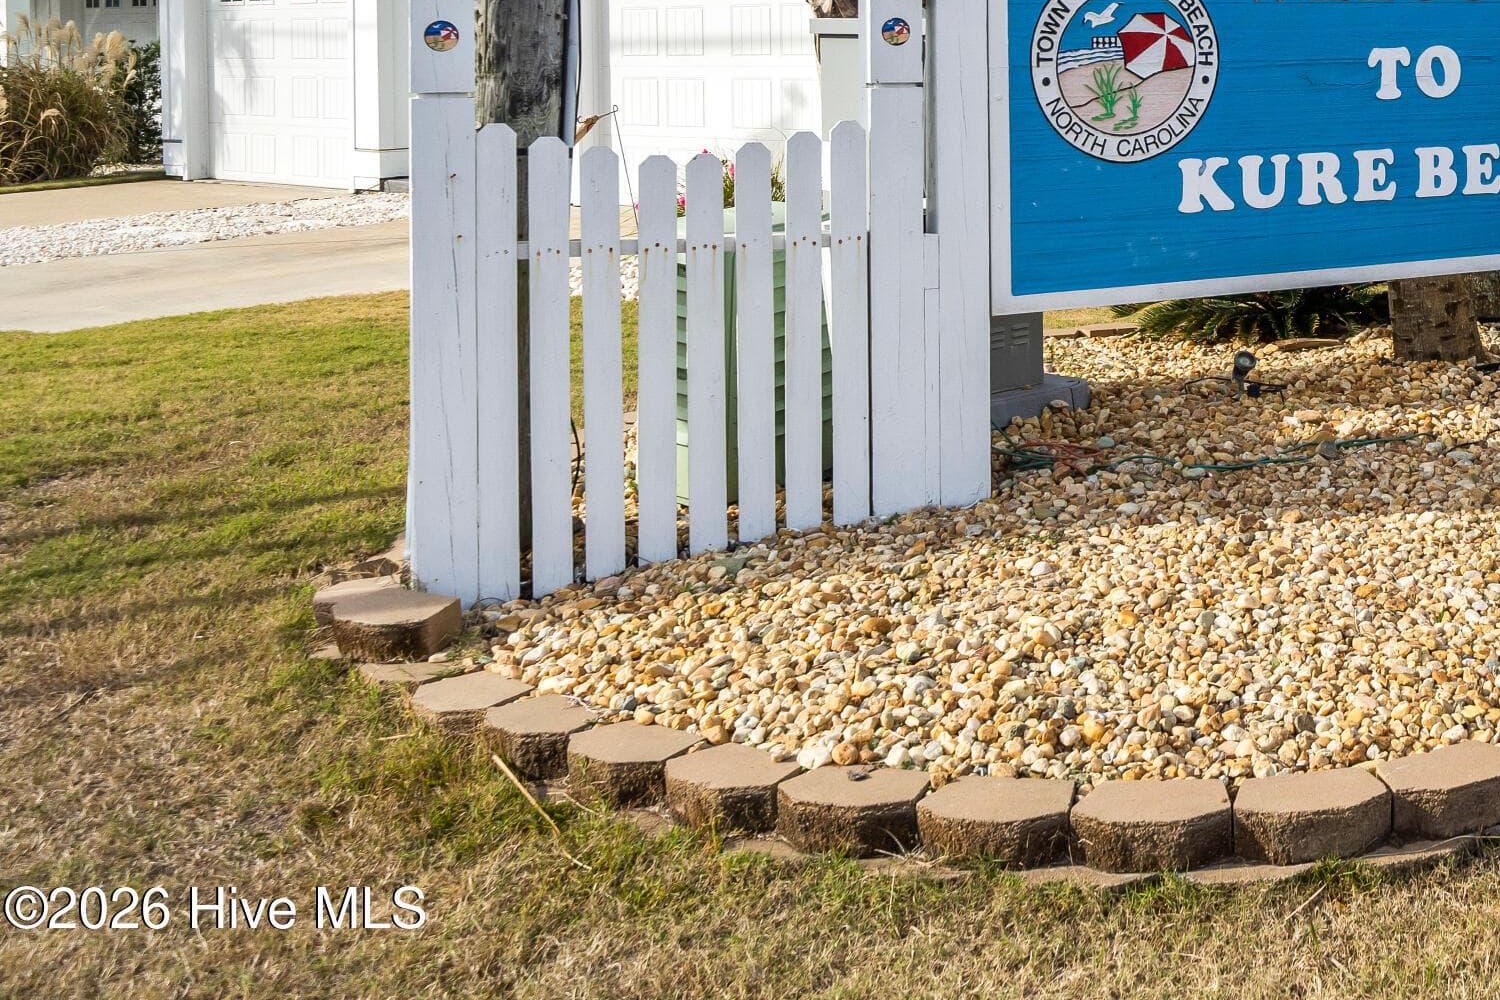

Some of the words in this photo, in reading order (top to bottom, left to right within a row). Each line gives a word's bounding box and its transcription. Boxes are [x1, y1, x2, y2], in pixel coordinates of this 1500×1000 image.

[1036, 0, 1070, 67] TOWN
[1368, 45, 1461, 100] TO
[1046, 97, 1107, 155] NORTH
[1116, 96, 1204, 157] CAROLINA
[1177, 148, 1397, 214] KURE
